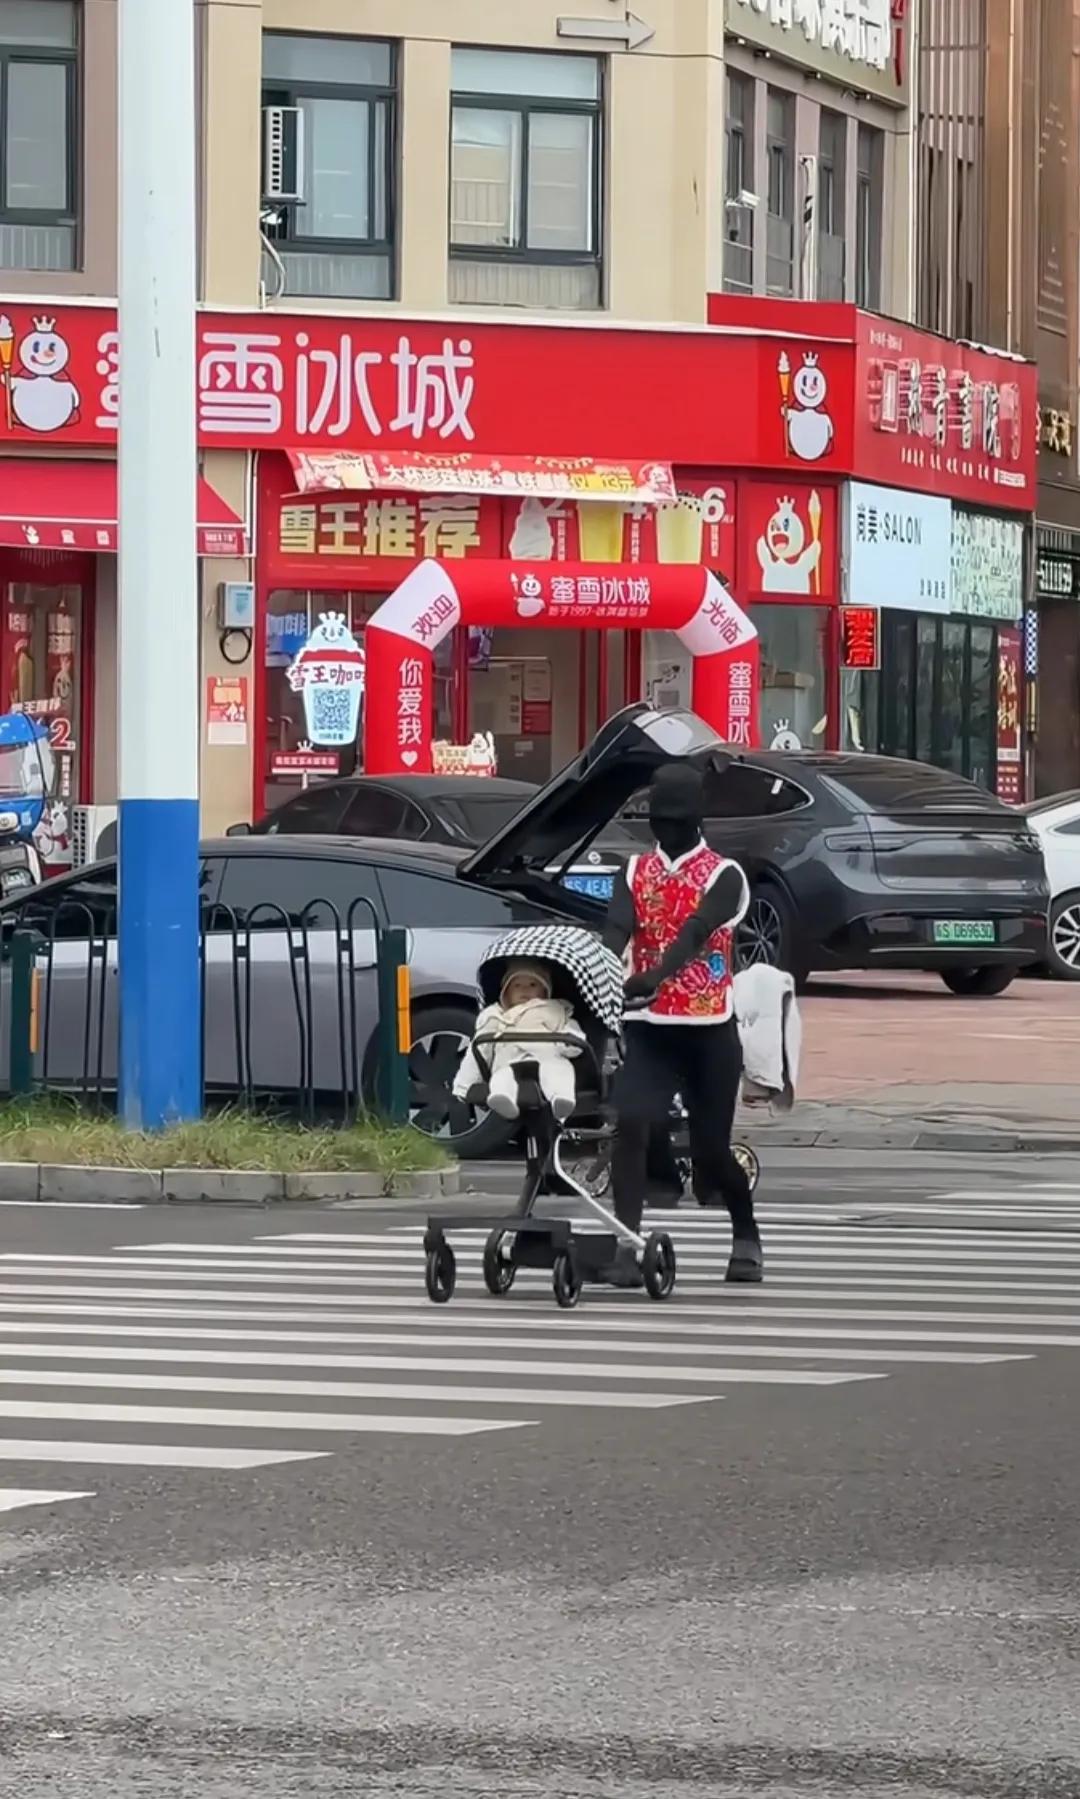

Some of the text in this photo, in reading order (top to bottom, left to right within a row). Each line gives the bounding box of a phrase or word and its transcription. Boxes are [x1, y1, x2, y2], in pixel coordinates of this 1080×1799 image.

[96, 332, 475, 441] 雪冰城
[280, 497, 480, 559] 雪王推荐
[411, 593, 457, 642] 欢迎
[550, 575, 651, 605] 蜜雪冰城
[701, 598, 744, 645] 光临
[397, 657, 423, 746] 你爱我
